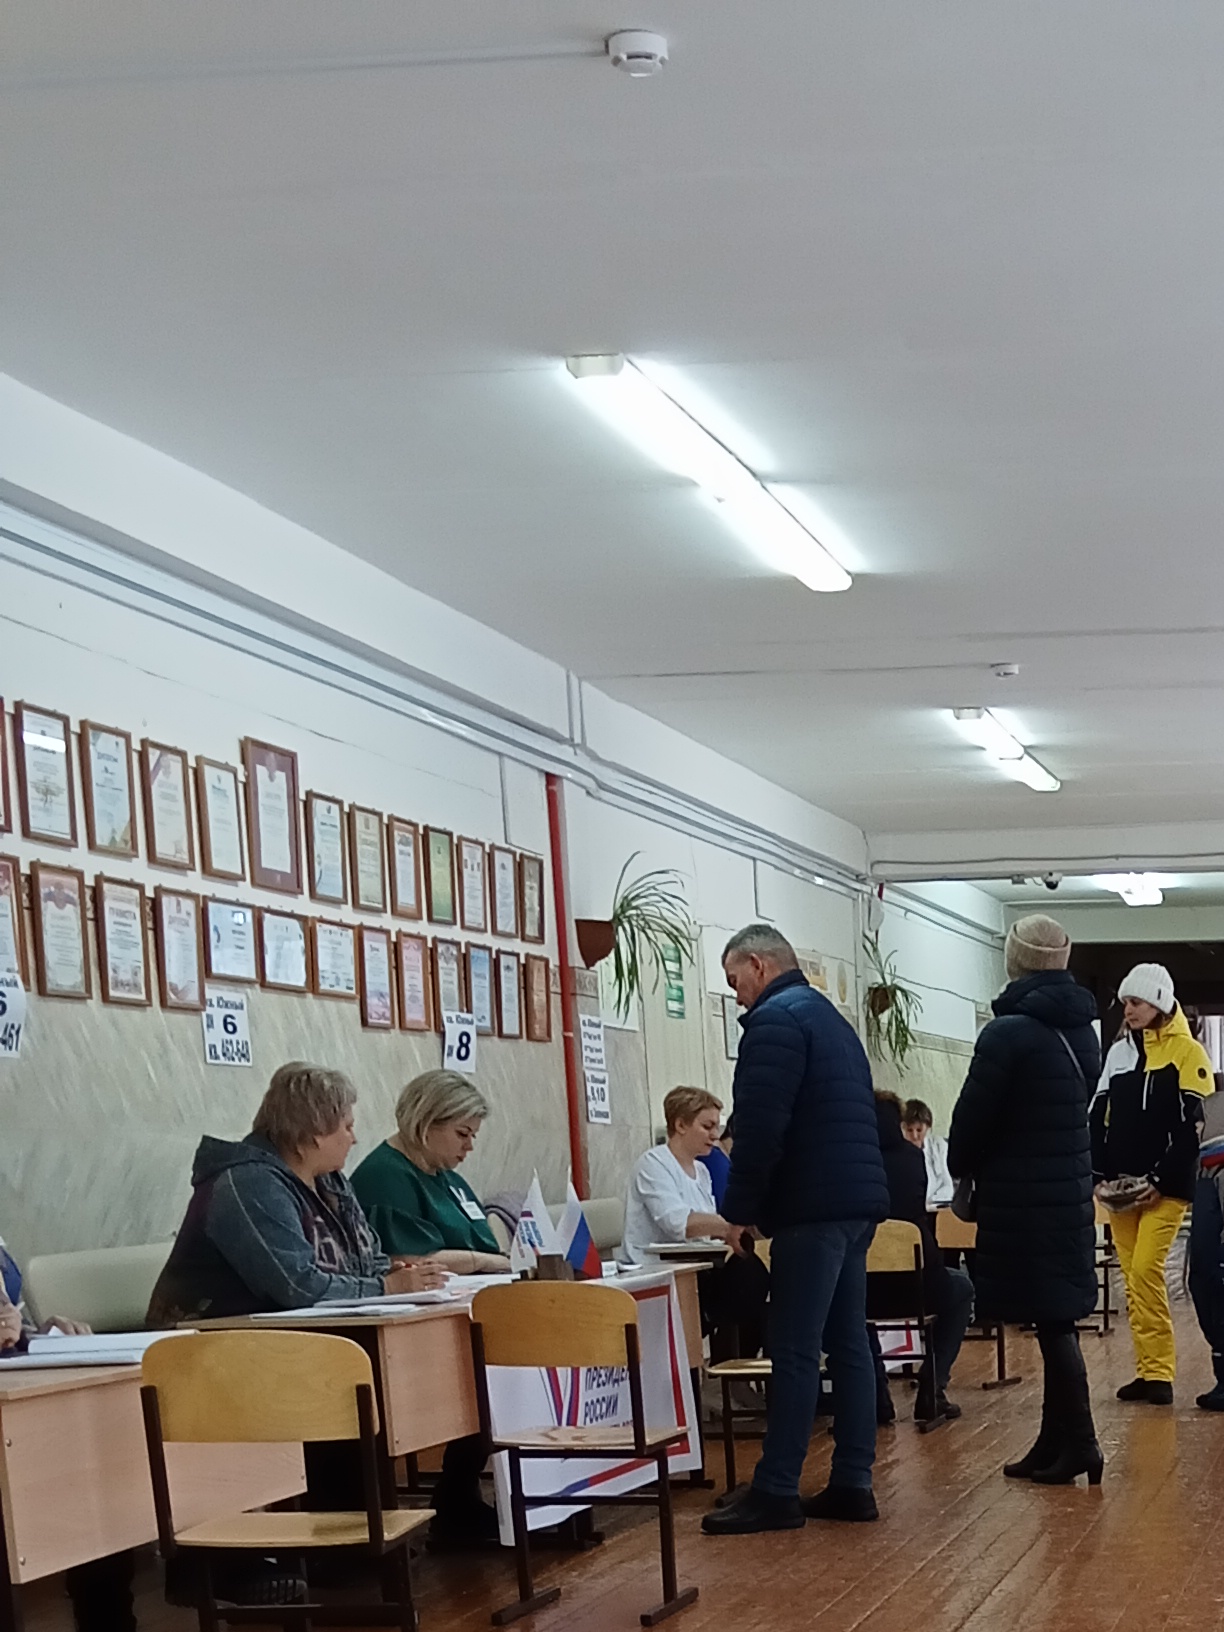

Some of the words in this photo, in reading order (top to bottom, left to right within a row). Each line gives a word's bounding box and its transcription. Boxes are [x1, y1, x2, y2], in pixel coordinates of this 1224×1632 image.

[223, 1014, 238, 1035] 6
[456, 1031, 471, 1062] 8
[583, 1393, 619, 1427] РОССИИ
